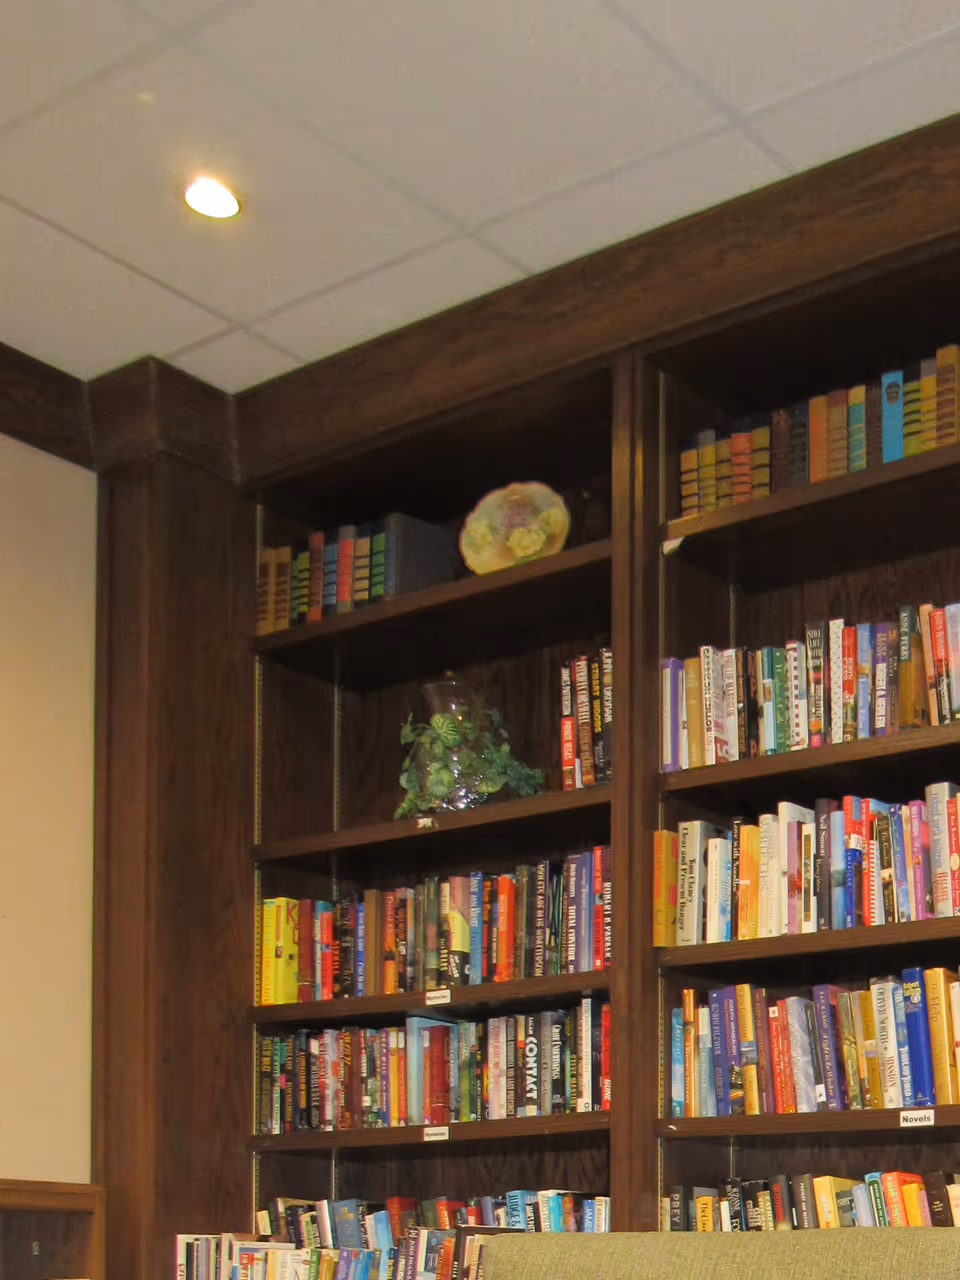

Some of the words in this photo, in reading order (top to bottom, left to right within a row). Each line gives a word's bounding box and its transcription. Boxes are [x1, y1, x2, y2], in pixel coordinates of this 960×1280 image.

[900, 612, 911, 634] ANNE
[901, 636, 912, 661] PERRY
[591, 662, 600, 697] STUART
[703, 648, 712, 696] GARRISON
[593, 698, 602, 734] WOODS
[705, 697, 713, 732] KEILLOR
[563, 720, 572, 742] PRIVATE
[565, 742, 573, 760] VEGAS
[733, 820, 741, 840] Love
[819, 813, 829, 831] Neil
[681, 827, 689, 847] Clear
[733, 841, 741, 860] with
[820, 831, 829, 858] Simon
[535, 864, 546, 894] VIOLETS
[688, 859, 697, 875] Tom
[733, 861, 741, 893] Noodles
[680, 866, 689, 901] Present
[686, 876, 697, 904] Clancy
[537, 895, 546, 909] ARE
[568, 905, 577, 928] TOTAL
[678, 901, 688, 932] Danger
[536, 935, 546, 977] PATTERSON
[712, 1003, 722, 1026] ROBIN
[876, 987, 889, 1016] OLIVER
[929, 995, 943, 1023] Help
[713, 1025, 724, 1056] PILCHER
[879, 1016, 891, 1045] NORTH
[525, 1036, 539, 1099] CONTACT
[885, 1056, 897, 1088] MISSION
[570, 1078, 578, 1107] MARTINI
[603, 1078, 611, 1101] GONE
[902, 1115, 932, 1124] Novels
[800, 1182, 808, 1201] PROTECT
[671, 1193, 680, 1225] PREY
[753, 1206, 761, 1227] CLIVE
